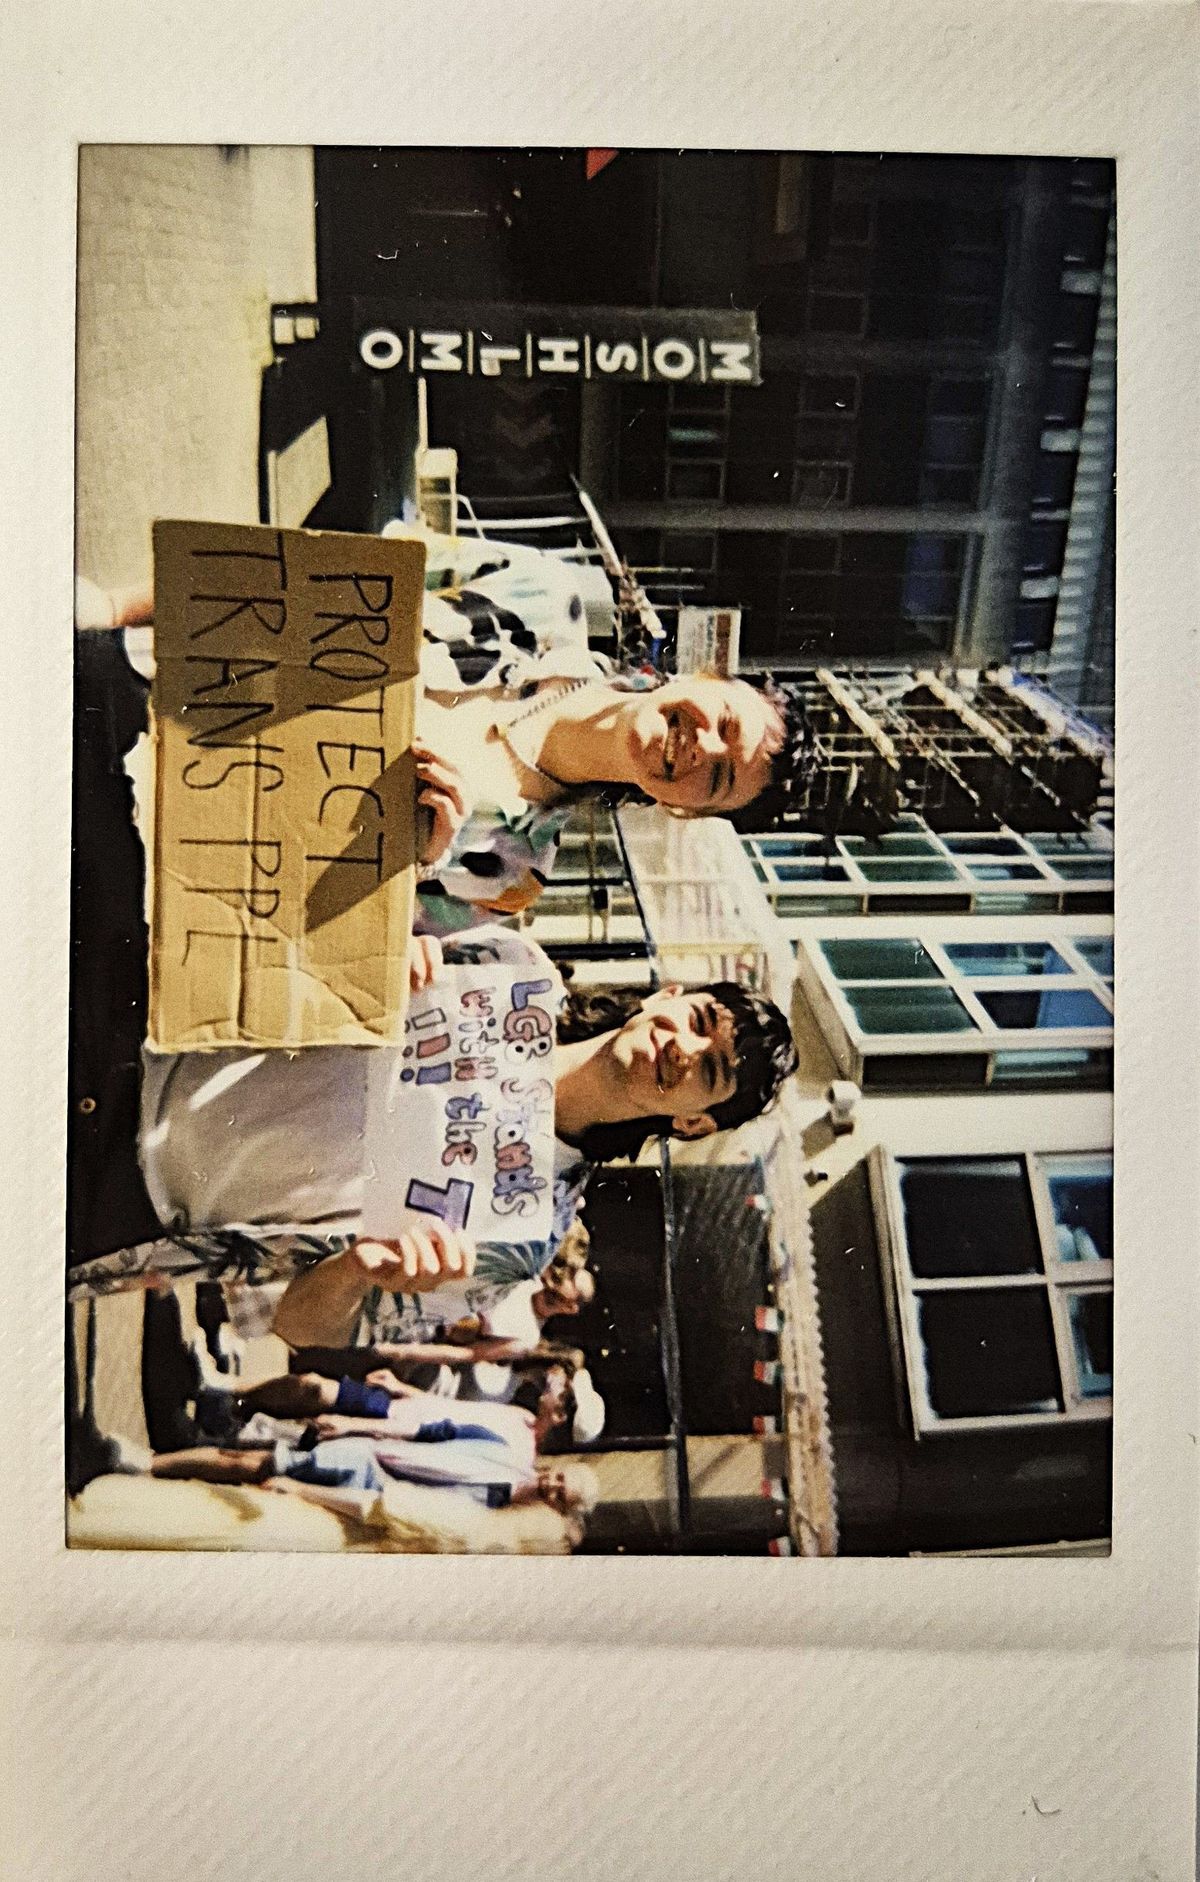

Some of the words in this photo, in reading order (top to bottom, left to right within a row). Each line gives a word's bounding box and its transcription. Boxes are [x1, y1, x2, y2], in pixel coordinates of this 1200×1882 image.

[181, 531, 288, 792] TRANS
[305, 573, 394, 881] PROTECT
[178, 838, 282, 967] PPL
[502, 978, 553, 1063] LGB
[441, 1092, 489, 1166] the
[404, 1177, 475, 1231] T
